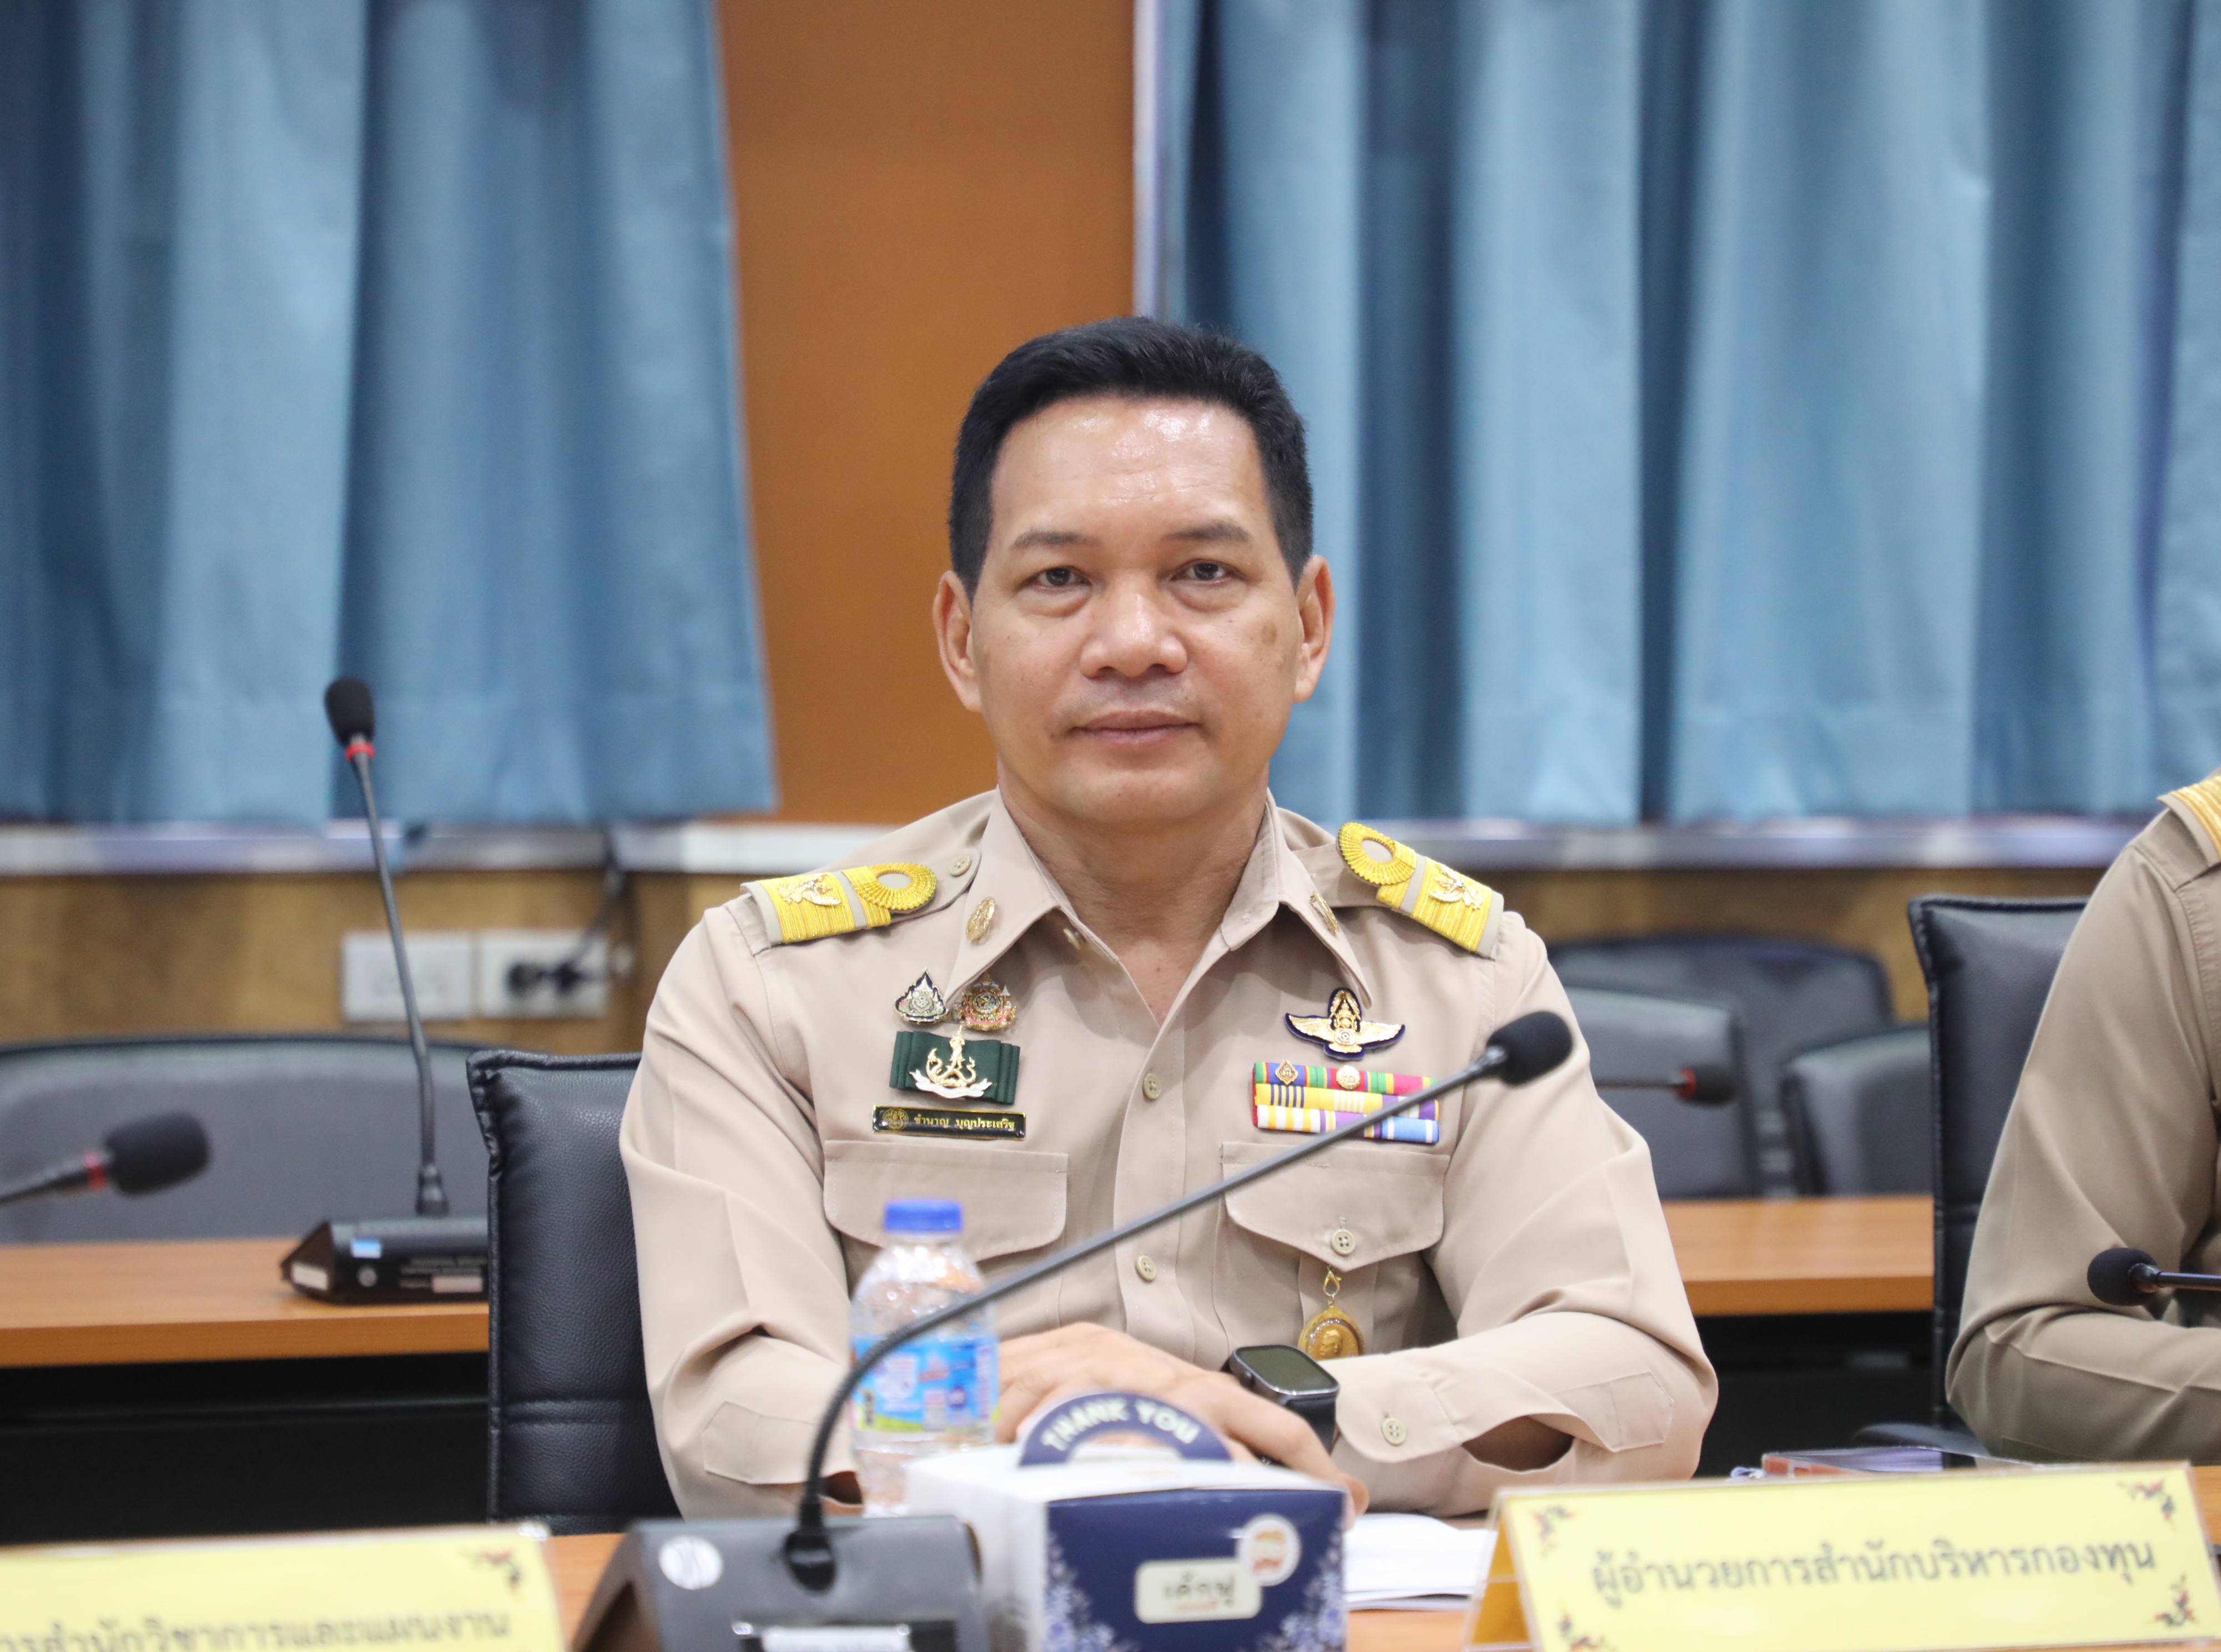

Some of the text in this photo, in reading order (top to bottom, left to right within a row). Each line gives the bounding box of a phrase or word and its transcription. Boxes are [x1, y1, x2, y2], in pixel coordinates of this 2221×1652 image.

[914, 1114, 1015, 1132] ชำนาญ บุญประเสริฐ
[1041, 1397, 1202, 1452] THANK YOU
[1592, 1538, 2157, 1610] ผู้อำนวยการสำนักบริหารกองทุน
